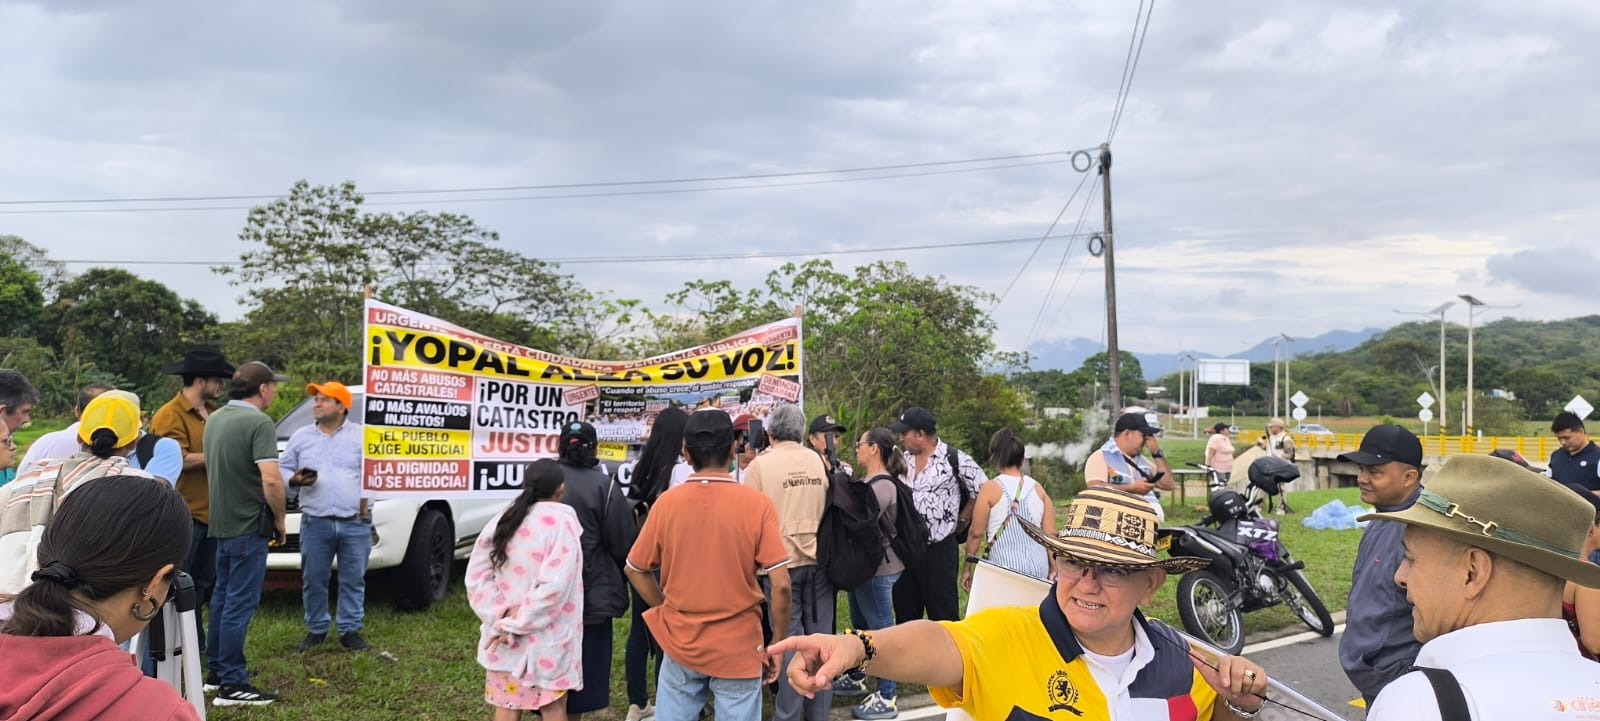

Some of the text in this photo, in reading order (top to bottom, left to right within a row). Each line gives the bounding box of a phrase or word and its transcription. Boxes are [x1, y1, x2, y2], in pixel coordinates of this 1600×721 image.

[371, 331, 529, 376] ¡YOPAL
[660, 358, 710, 379] SU
[719, 343, 795, 376] VOZ!
[392, 369, 418, 384] MÁS
[421, 373, 466, 388] ABUSOS
[375, 383, 458, 399] CATASTRALES!
[480, 381, 563, 408] ¡POR UN
[645, 386, 668, 395] abuso
[387, 399, 413, 414] MÁS
[415, 402, 467, 417] AVALÚOS
[613, 400, 645, 408] territorio
[384, 414, 445, 427] INJUSTOS!
[380, 431, 449, 443] ¡EL PUEBLO
[481, 432, 560, 453] JUSTO
[368, 443, 464, 455] EXIGE JUSTICIA!
[373, 462, 459, 475] ¡LA DIGNIDAD
[386, 476, 402, 488] SE
[405, 476, 466, 488] NEGOCIA!
[1237, 526, 1278, 541] XTZ
